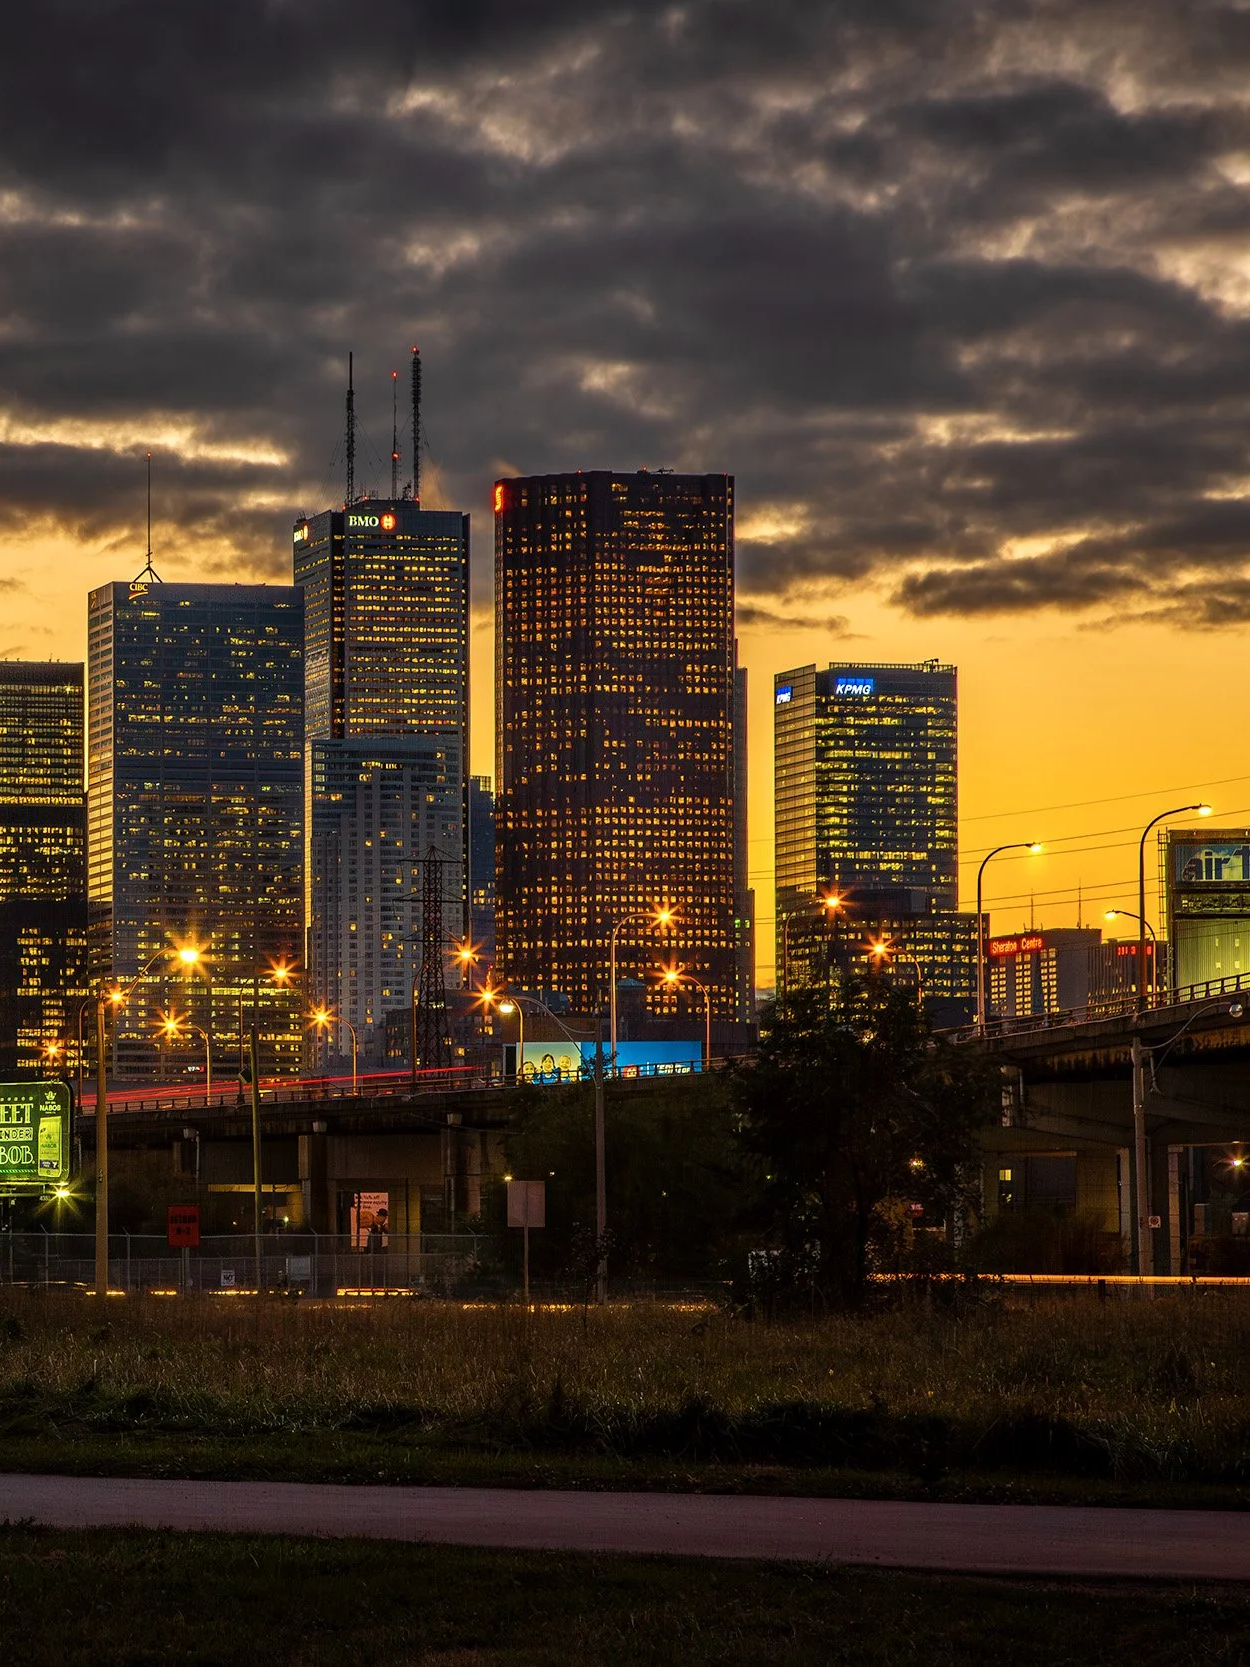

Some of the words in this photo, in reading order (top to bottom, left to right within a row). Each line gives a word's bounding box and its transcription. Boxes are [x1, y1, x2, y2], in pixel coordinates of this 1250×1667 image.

[348, 515, 379, 527] BMO
[129, 583, 149, 592] CIBC
[836, 684, 871, 695] KPMG
[992, 940, 1017, 953] Sheraton
[1021, 937, 1042, 950] Centre
[39, 1104, 61, 1112] NABOB
